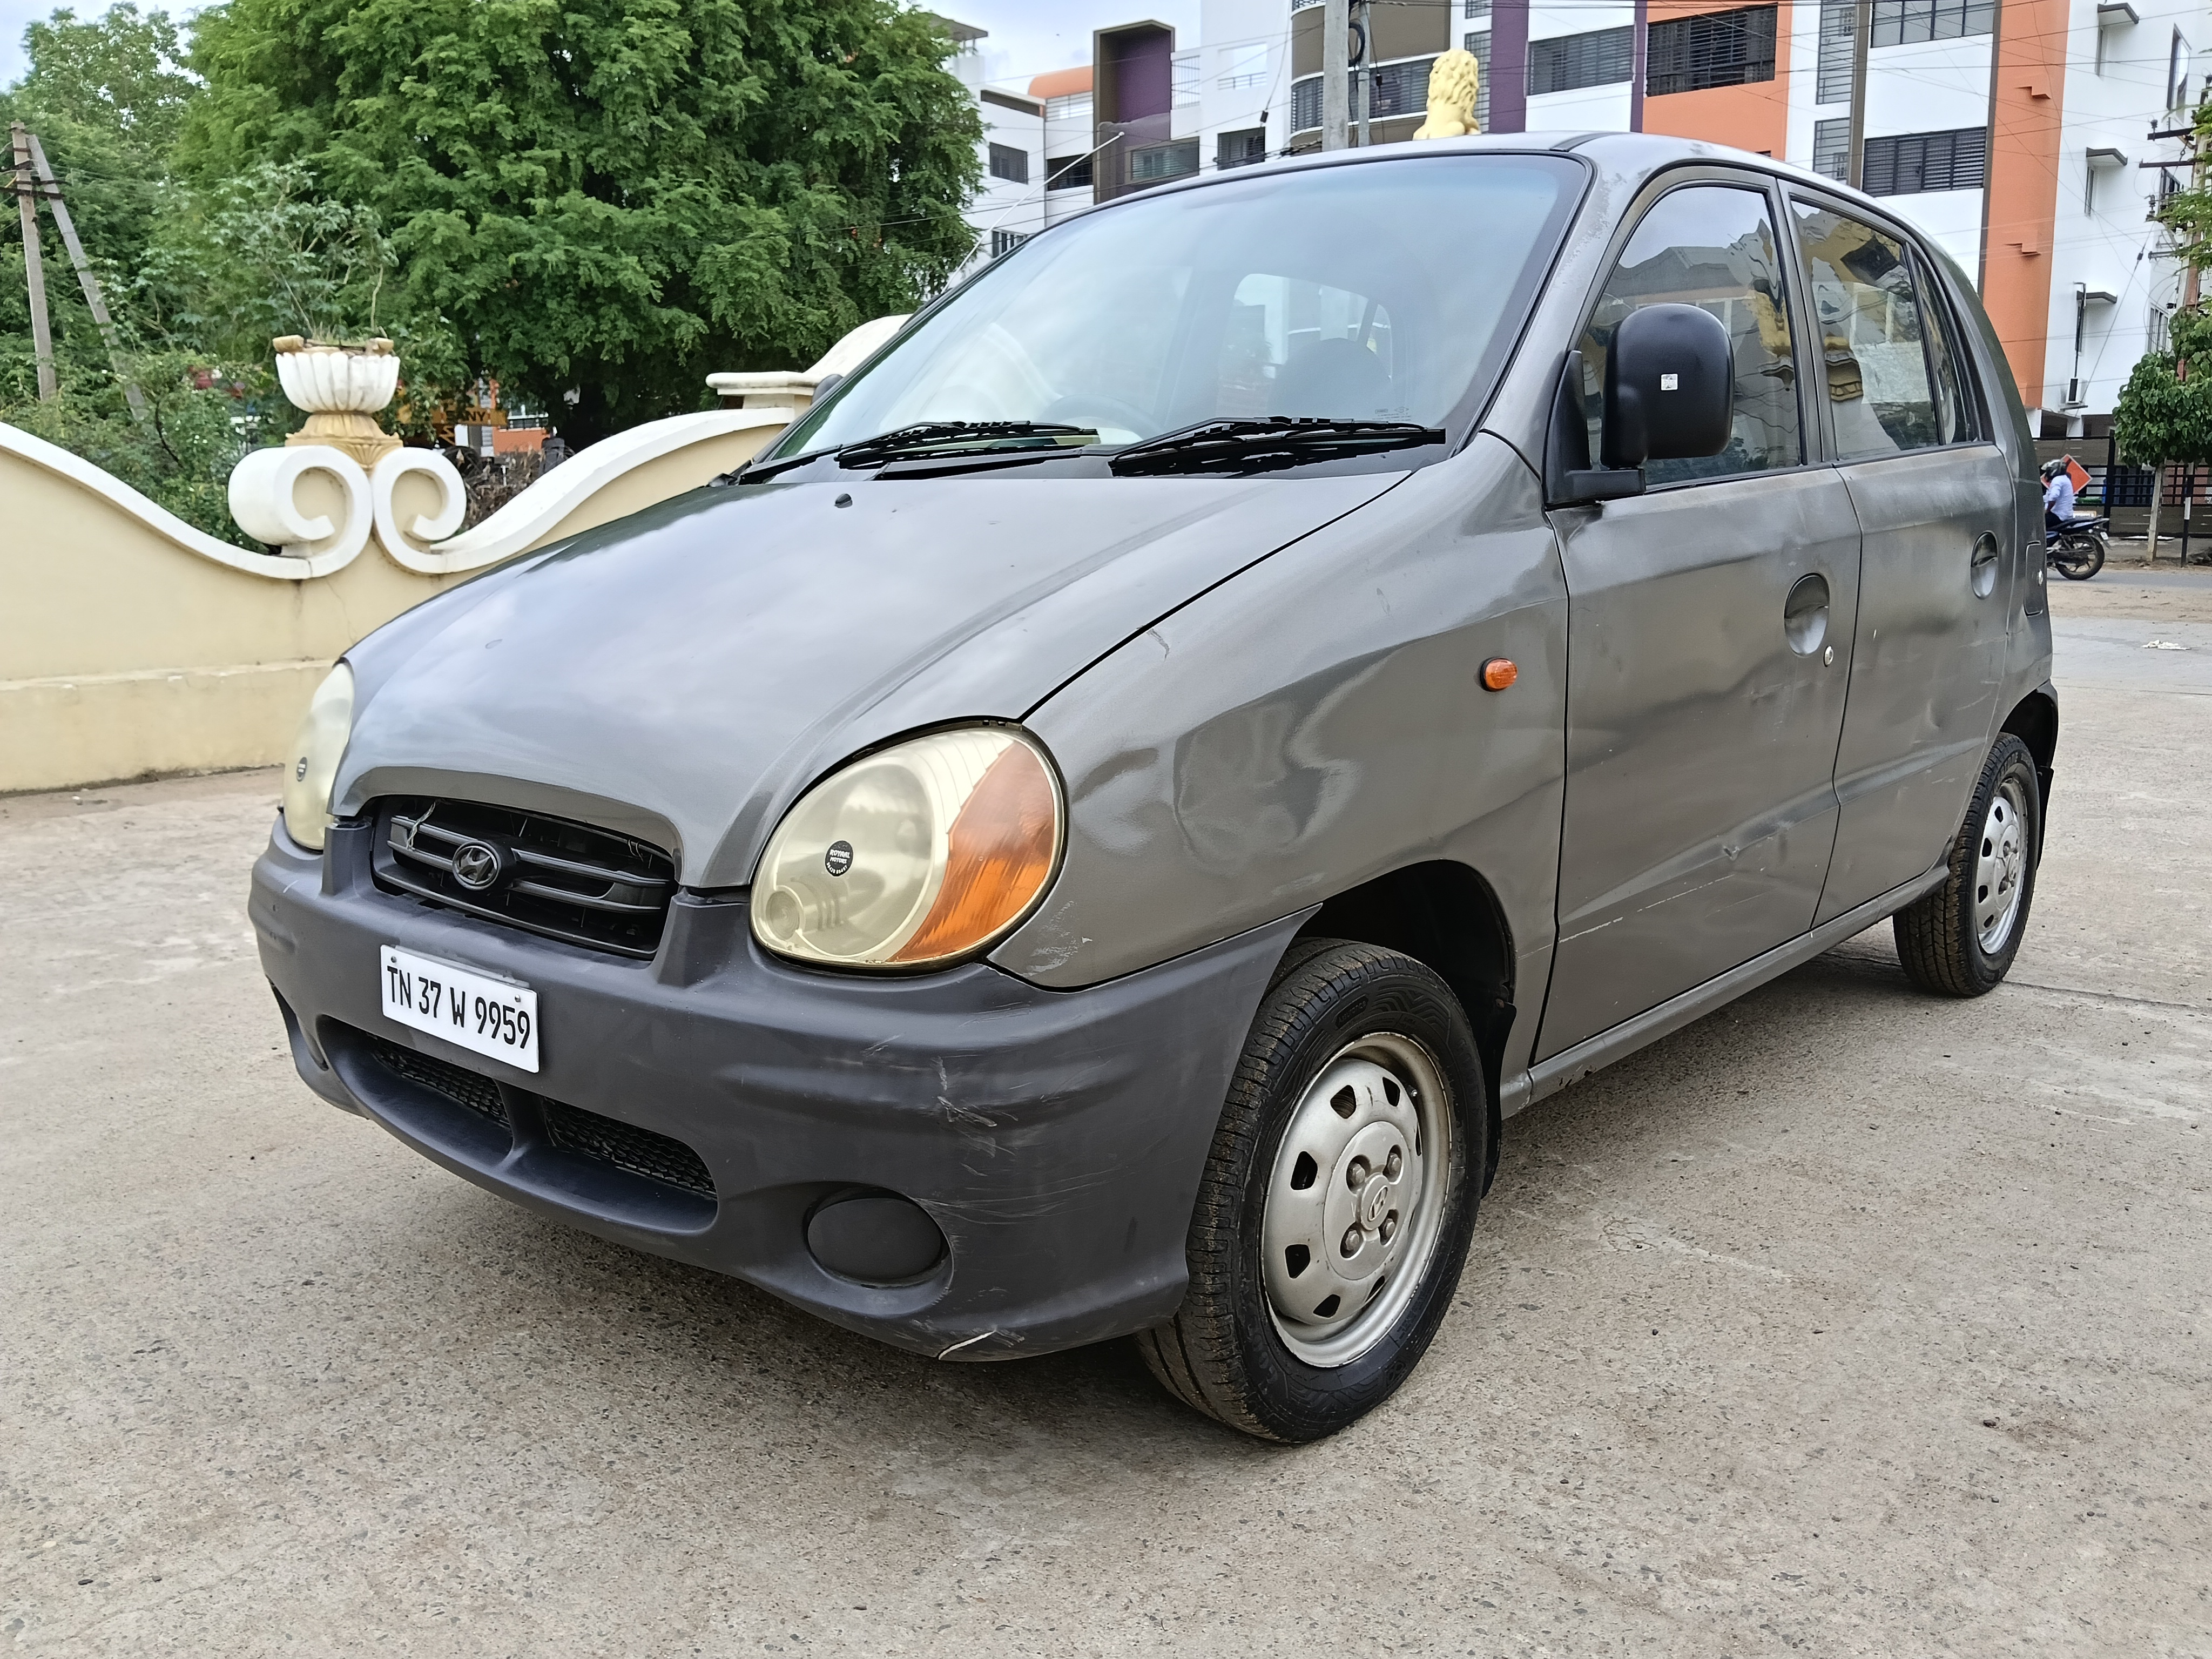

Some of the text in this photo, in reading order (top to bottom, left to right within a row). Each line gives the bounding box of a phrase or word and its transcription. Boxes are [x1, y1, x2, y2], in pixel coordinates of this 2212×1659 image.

[830, 849, 850, 859] ROYAAL
[387, 966, 530, 1049] TN 37 W 9959
